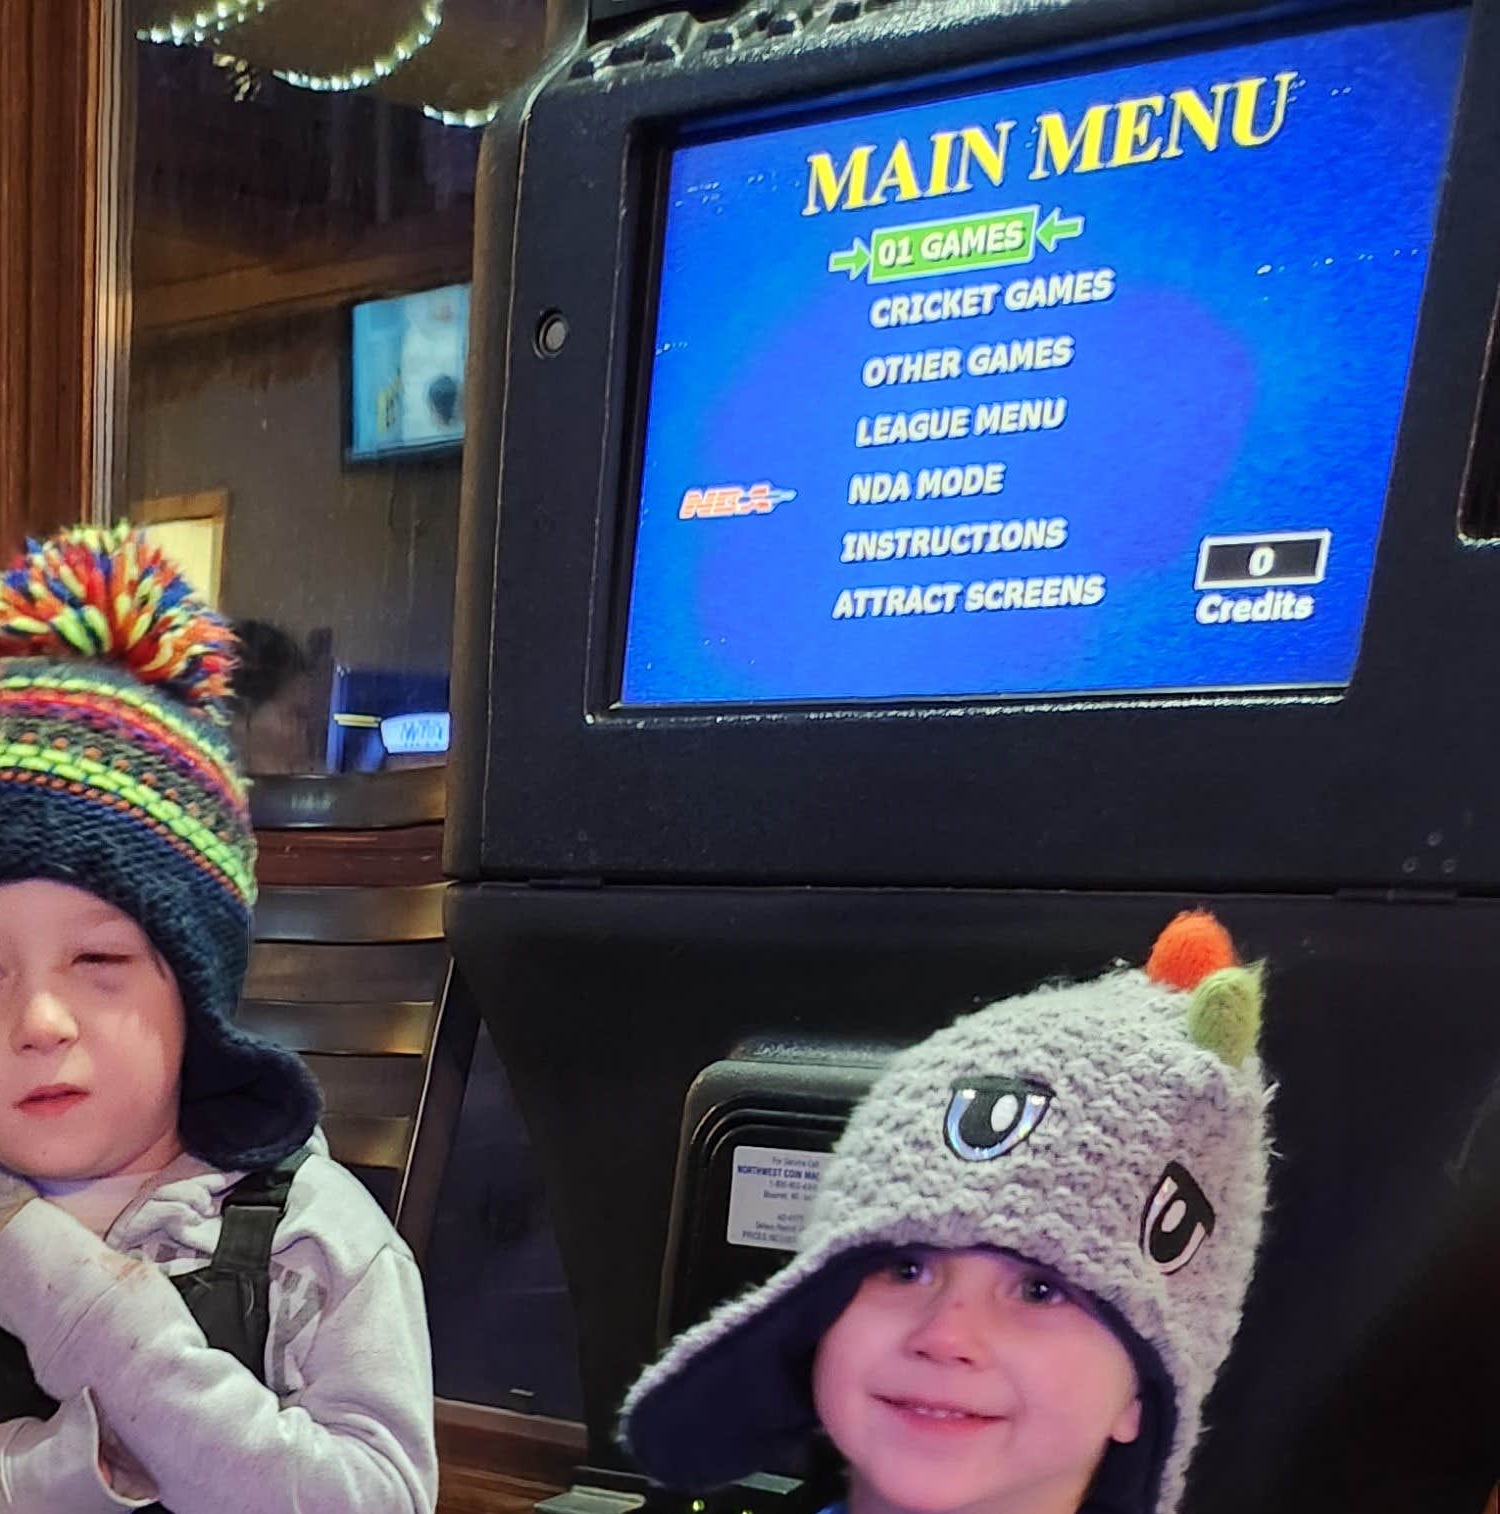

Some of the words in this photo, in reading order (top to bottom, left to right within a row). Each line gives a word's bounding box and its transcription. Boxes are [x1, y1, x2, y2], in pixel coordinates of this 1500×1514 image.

[802, 120, 1016, 217] MAIN
[1029, 72, 1298, 181] MENU
[877, 236, 911, 268] 01
[920, 219, 1026, 261] GAMES
[869, 283, 1000, 329] CRICKET
[1004, 267, 1117, 311] GAMES
[862, 347, 961, 388] OTHER
[967, 335, 1075, 376] GAMES
[855, 406, 971, 447] LEAGUE
[972, 396, 1068, 435] MENU
[848, 470, 910, 505] NDA
[915, 462, 1006, 500] MODE
[840, 517, 1068, 563] INSTRUCTIONS
[832, 581, 962, 619] ATTRACT
[964, 573, 1106, 612] SCREENS
[1195, 589, 1316, 624] Credits
[784, 1169, 803, 1178] COIN
